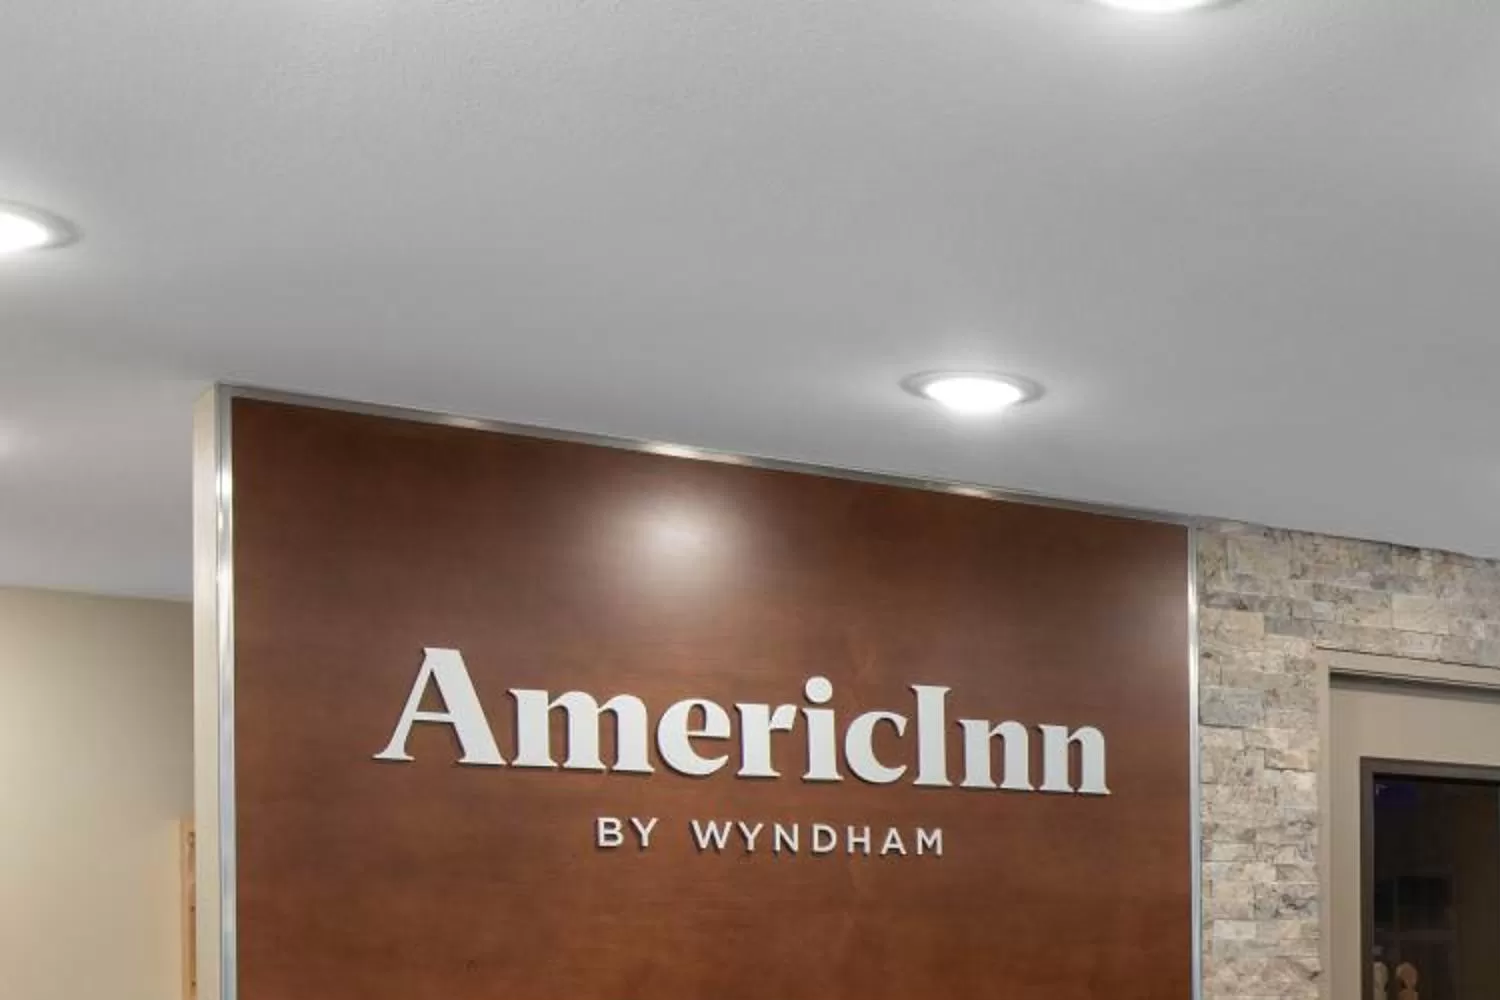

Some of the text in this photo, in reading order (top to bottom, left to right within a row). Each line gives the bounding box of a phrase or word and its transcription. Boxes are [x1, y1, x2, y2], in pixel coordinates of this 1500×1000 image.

[373, 647, 1111, 795] AmericInn
[597, 817, 944, 856] BY WYNDHAM
